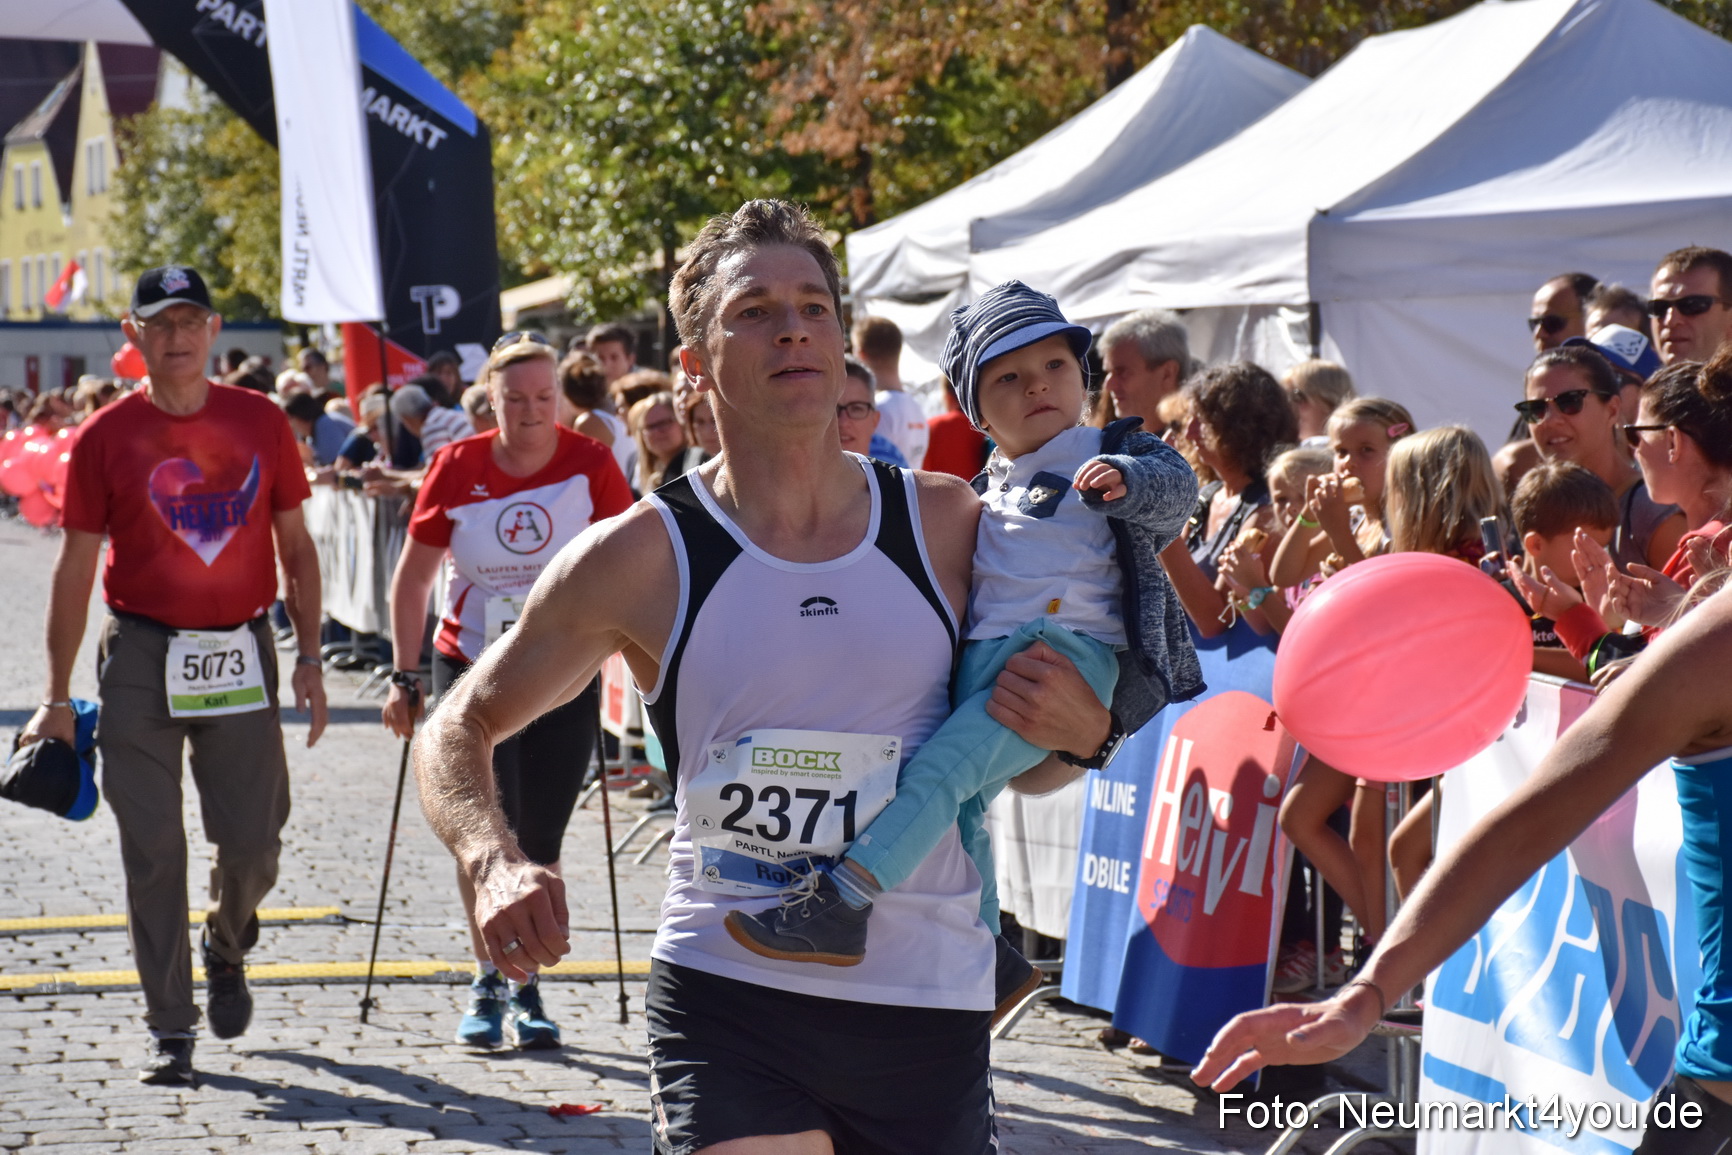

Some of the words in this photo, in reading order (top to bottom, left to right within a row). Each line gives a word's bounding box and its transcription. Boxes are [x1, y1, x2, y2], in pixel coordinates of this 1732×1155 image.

[195, 0, 267, 48] PART
[800, 607, 839, 617] skinfit
[182, 648, 246, 682] 5073
[203, 694, 229, 708] Karl
[752, 746, 842, 772] BOCK
[751, 767, 779, 777] inspired
[780, 769, 789, 777] by
[811, 772, 842, 781] concepts
[702, 818, 710, 827] A
[719, 782, 858, 844] 2371
[735, 839, 774, 858] PARTL
